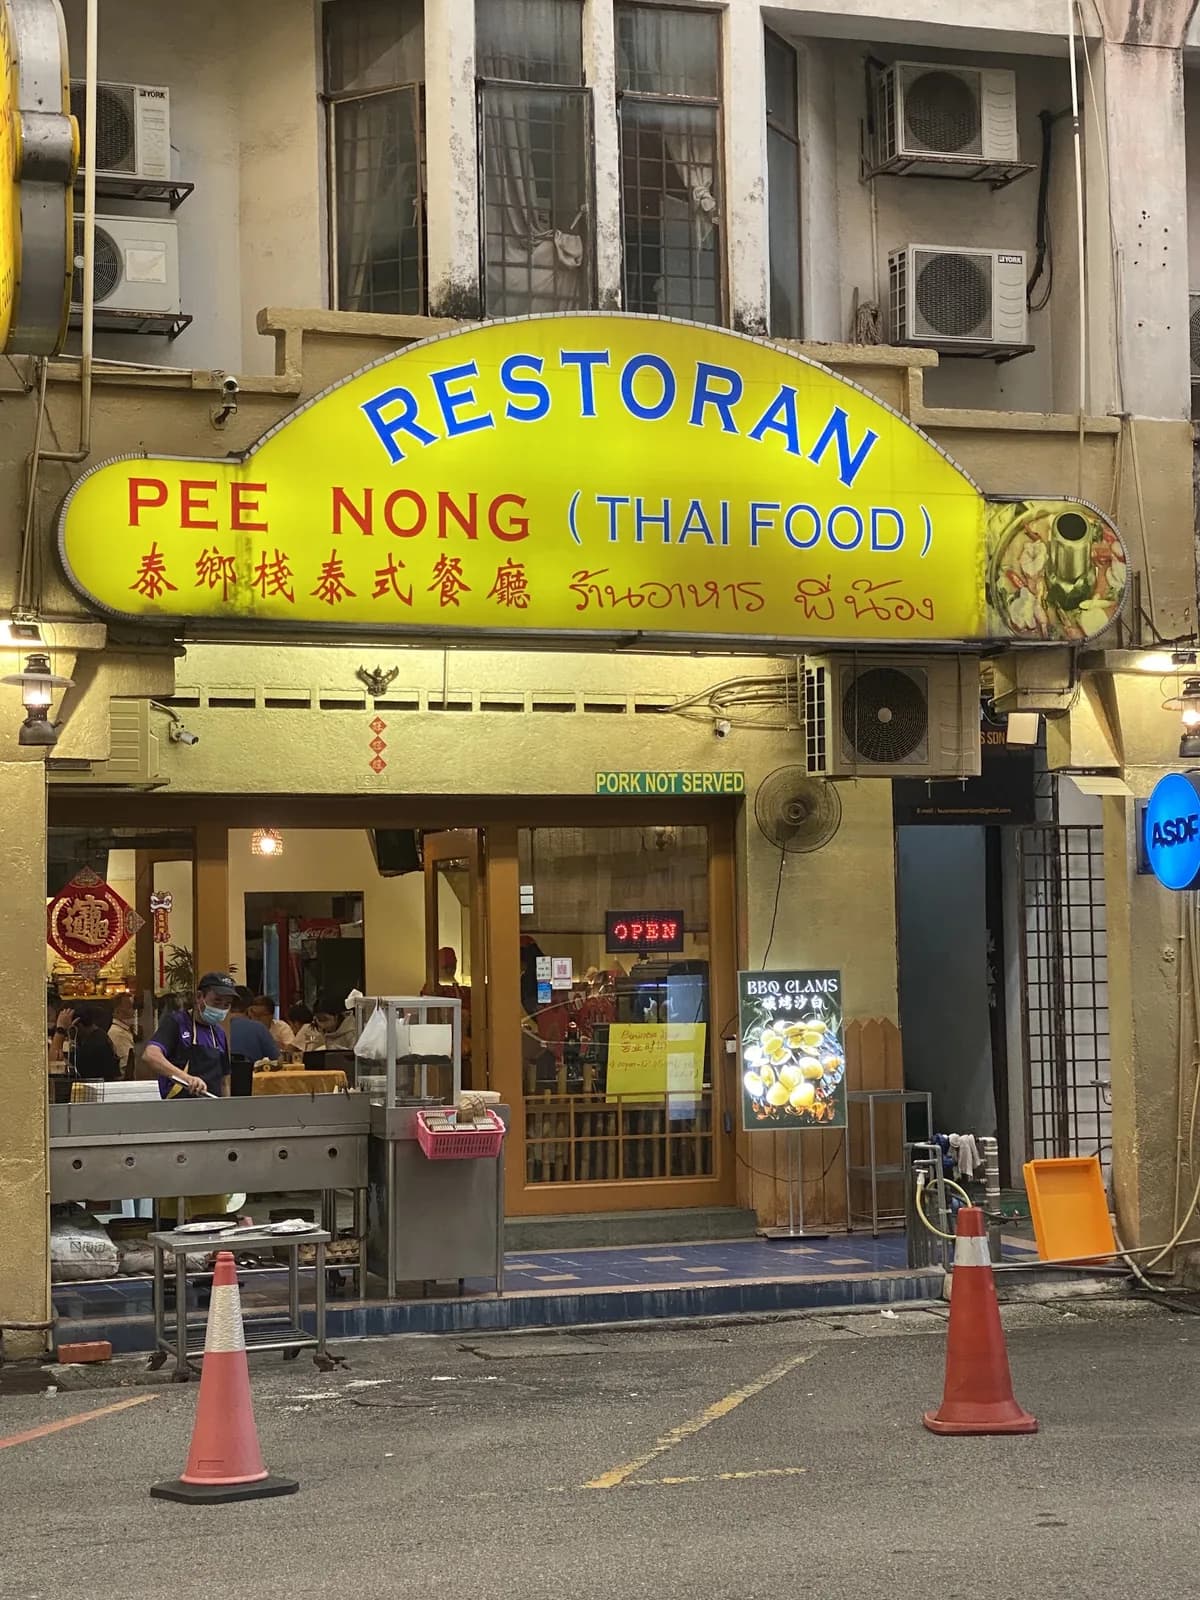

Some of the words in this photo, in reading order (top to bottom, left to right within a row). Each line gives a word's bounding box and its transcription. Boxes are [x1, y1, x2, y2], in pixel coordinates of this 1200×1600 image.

[359, 349, 879, 488] RESTORAN
[127, 477, 268, 532] PEE
[331, 486, 530, 542] NONG
[568, 568, 766, 611] ร้านอาหาร
[597, 773, 641, 792] PORK
[646, 773, 677, 792] NOT
[682, 772, 744, 792] SERVED
[1152, 814, 1199, 848] ASDF
[614, 924, 676, 939] OPEN
[747, 980, 782, 996] BBQ
[785, 979, 838, 994] CLAMS
